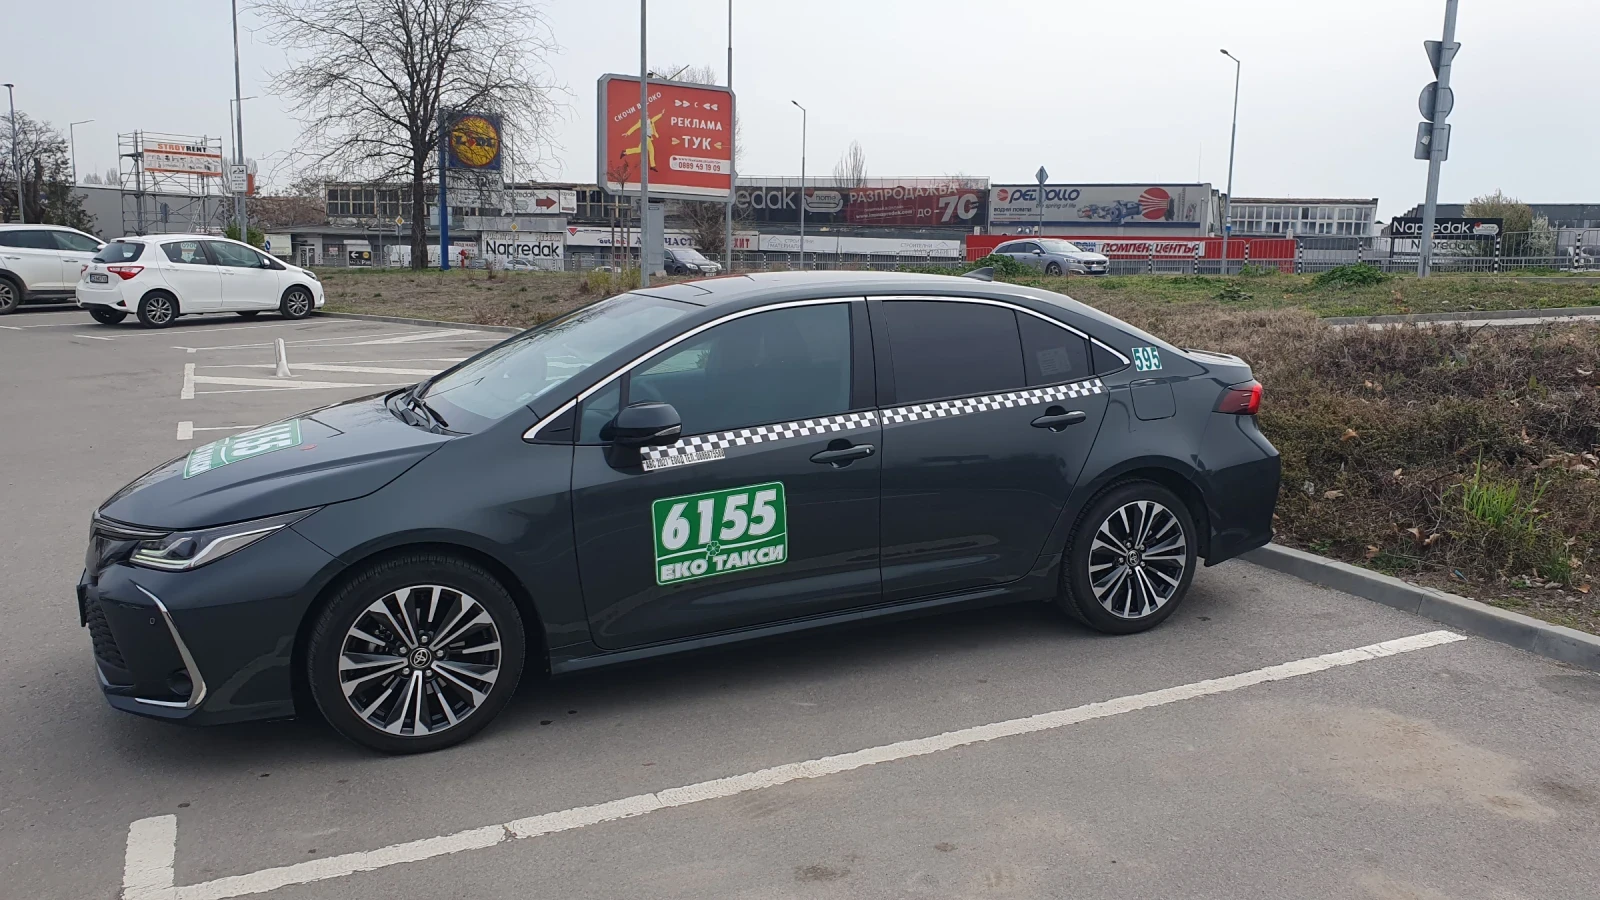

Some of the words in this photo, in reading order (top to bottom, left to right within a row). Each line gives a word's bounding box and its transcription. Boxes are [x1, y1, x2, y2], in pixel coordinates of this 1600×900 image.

[614, 106, 636, 122] СКОЧИ
[637, 91, 662, 111] ВОКО
[670, 116, 723, 131] РЕКЛАМА
[157, 143, 207, 153] STROYRENT
[682, 135, 712, 150] ТУК
[678, 161, 693, 170] 0889
[695, 163, 704, 171] 49
[705, 163, 712, 171] 19
[713, 164, 721, 172] 09
[815, 193, 837, 201] home
[849, 182, 958, 204] РАЗПРОДАЖБА
[1393, 220, 1471, 236] Napedak
[485, 240, 560, 259] Napredak
[733, 238, 750, 249] ХИТ
[1133, 347, 1161, 371] 595
[661, 488, 777, 551] 6155
[660, 558, 708, 582] ЕКО
[712, 544, 784, 571] ТАКСИ
